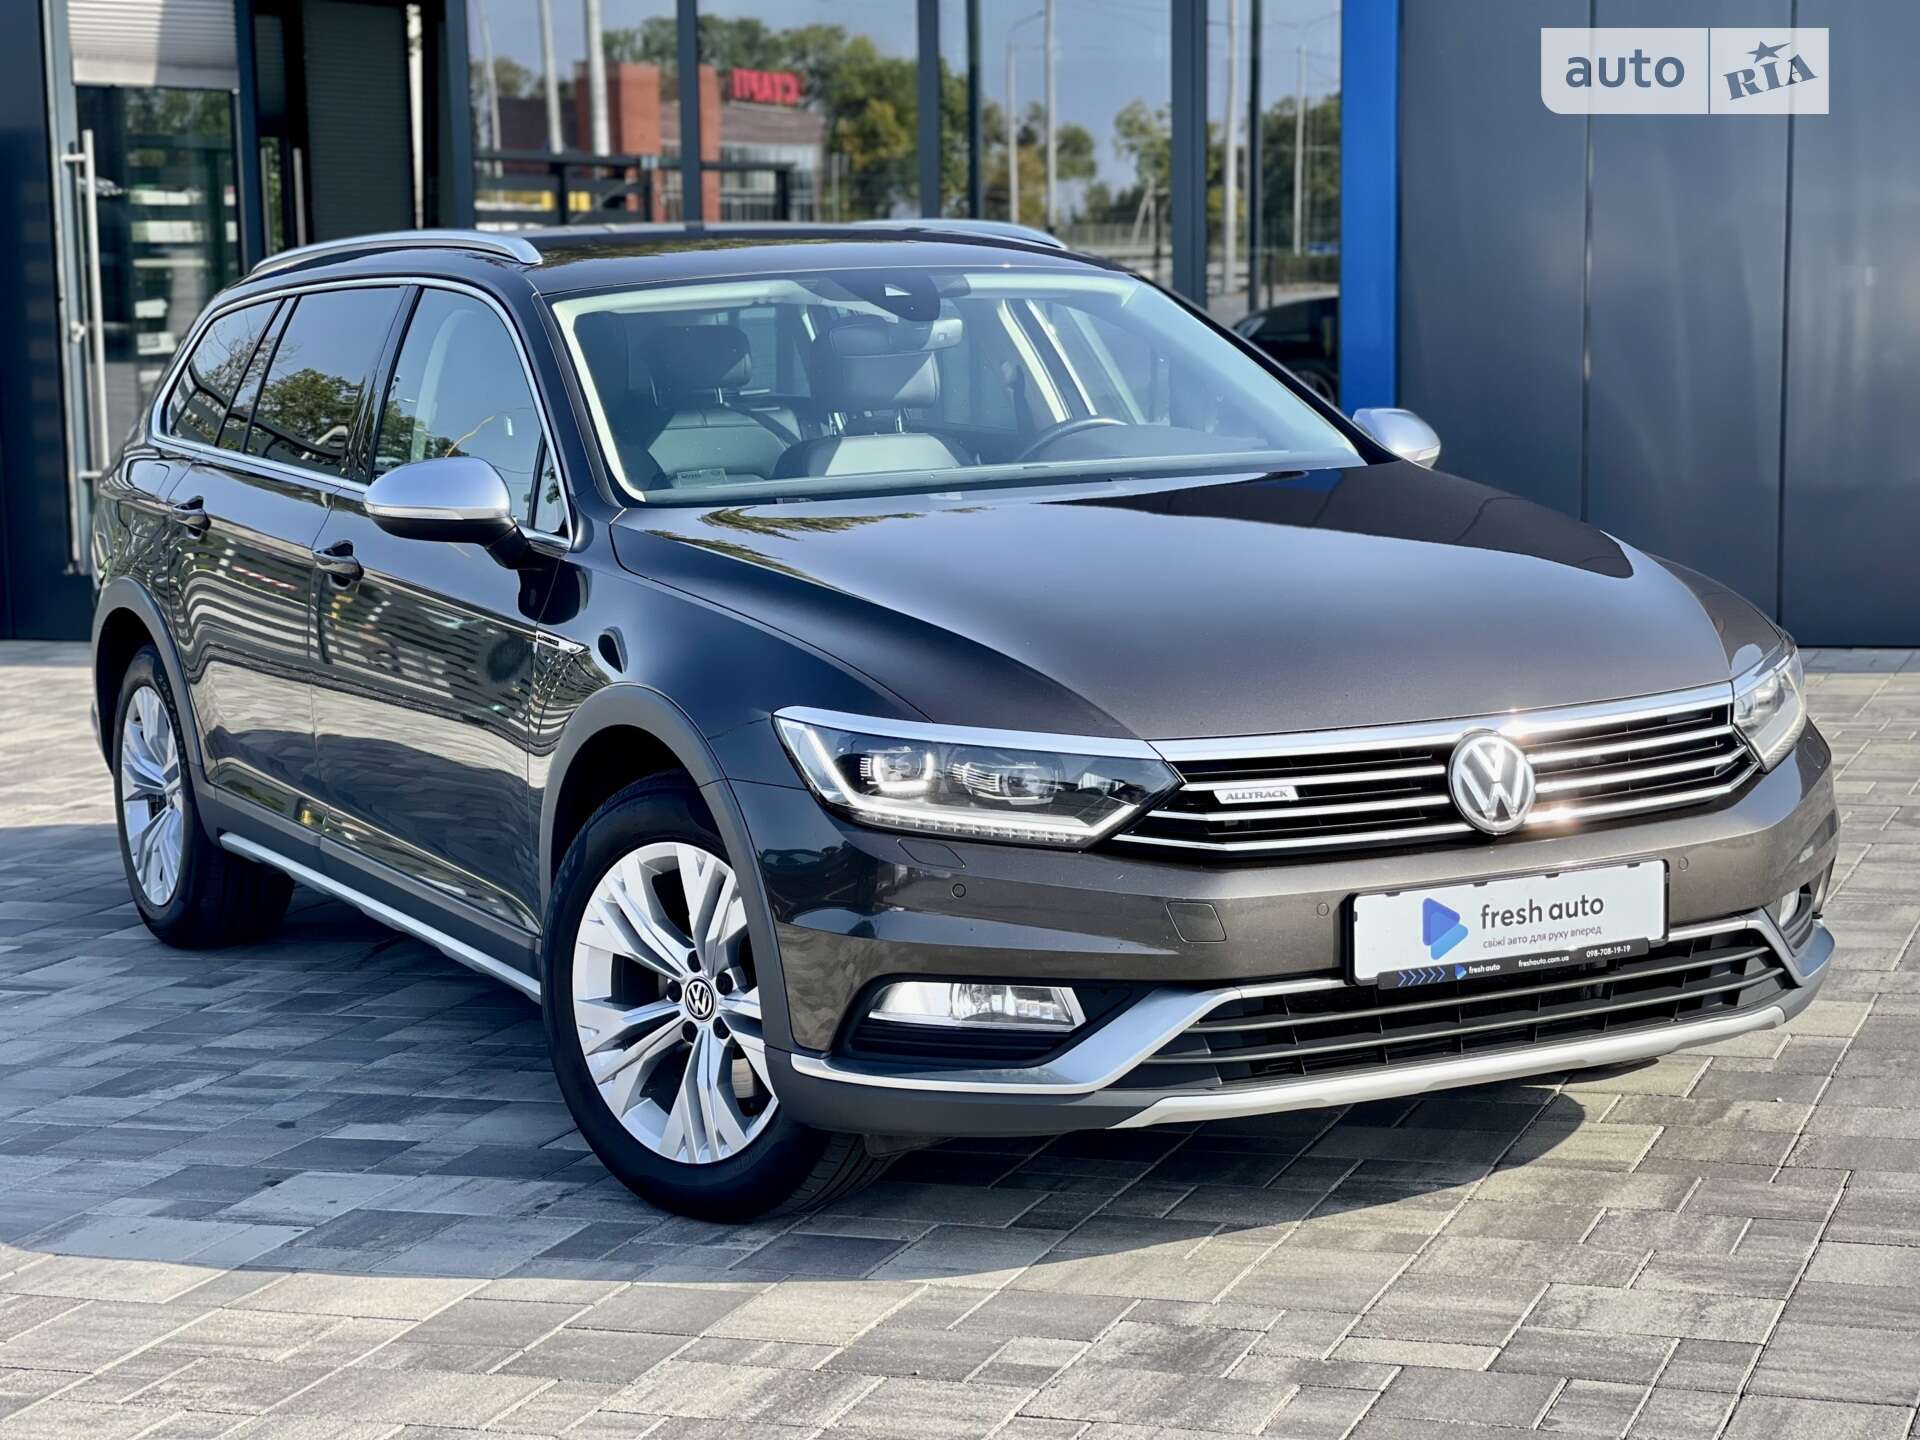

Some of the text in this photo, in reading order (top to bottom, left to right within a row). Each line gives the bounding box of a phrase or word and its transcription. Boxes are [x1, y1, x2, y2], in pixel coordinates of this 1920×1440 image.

[1225, 790, 1288, 800] ALLTRACK
[1481, 894, 1604, 929] fresh auto
[1507, 936, 1528, 946] авто
[1529, 934, 1547, 945] для
[1548, 930, 1569, 942] руху
[1570, 926, 1602, 937] вперед
[1518, 955, 1570, 968] freshauto.com.ua
[1469, 963, 1501, 975] fresh auto
